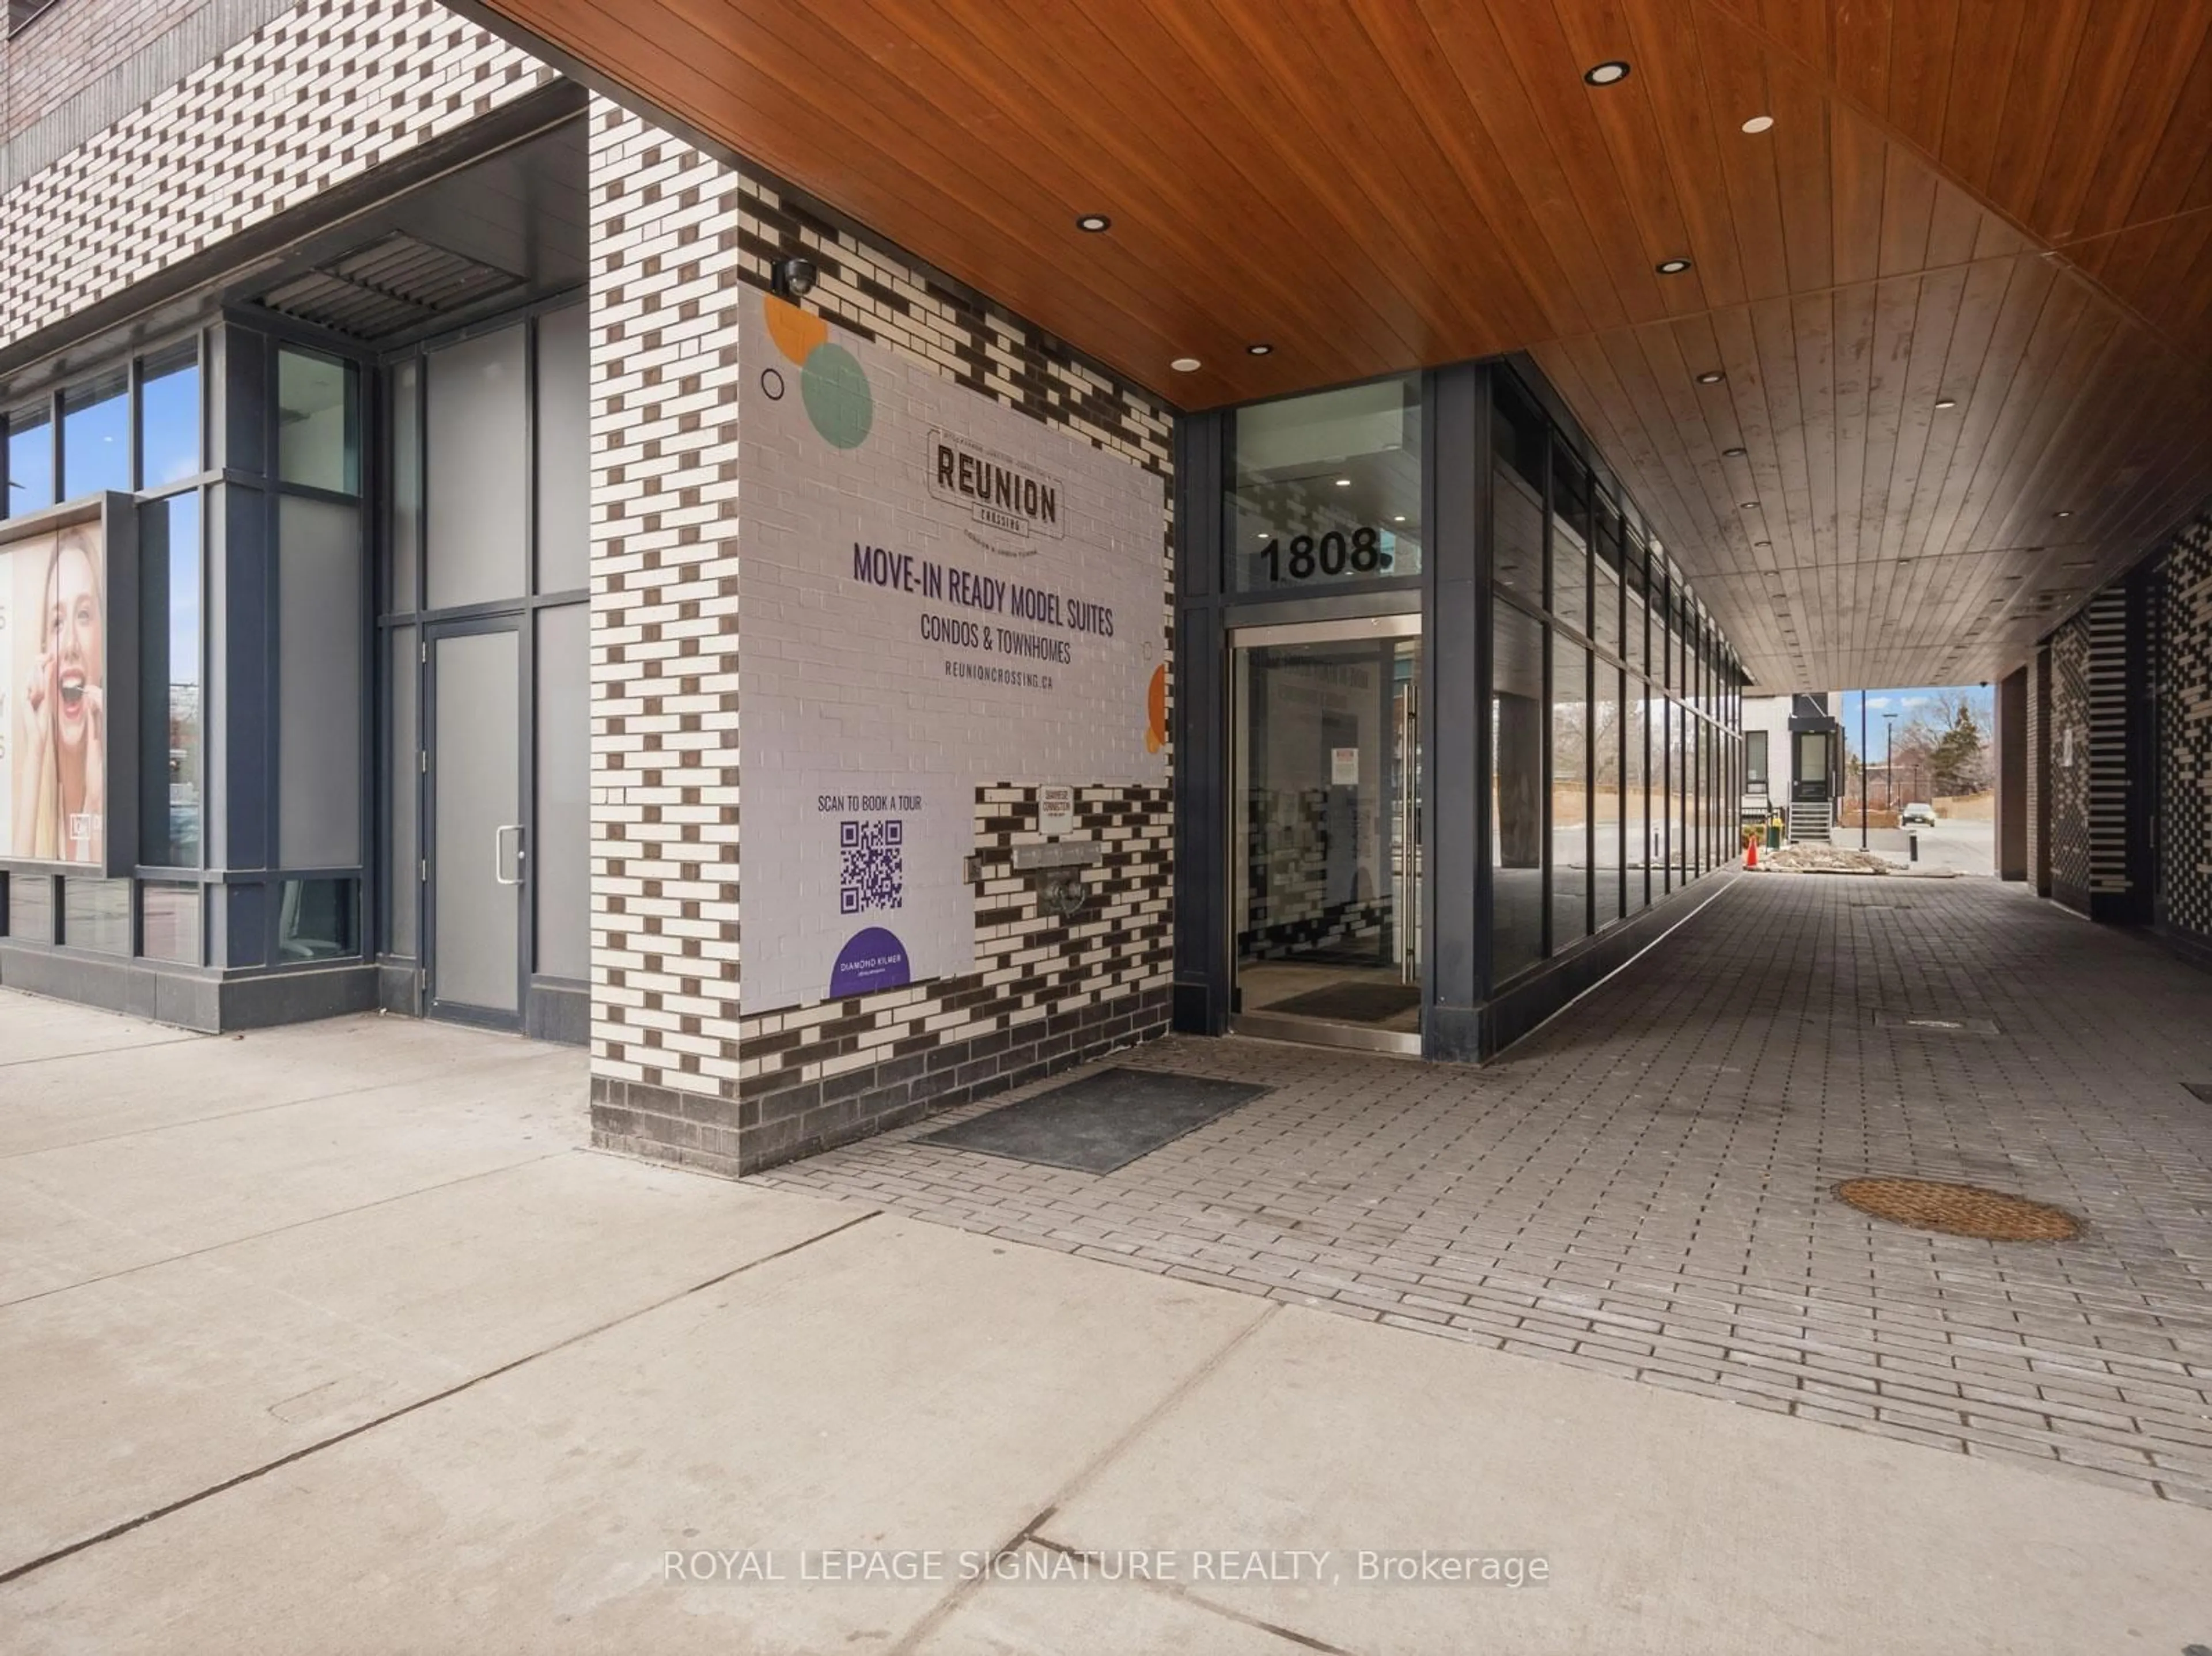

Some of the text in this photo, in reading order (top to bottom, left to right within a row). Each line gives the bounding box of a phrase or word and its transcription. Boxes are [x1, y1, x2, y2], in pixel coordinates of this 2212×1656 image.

[938, 444, 1055, 523] REUNION
[1261, 526, 1378, 582] 1808
[854, 543, 942, 600] MOVE-IN
[949, 568, 1006, 613] READY
[1012, 584, 1063, 626] MODEL
[1067, 598, 1114, 638] SUITES
[921, 613, 1071, 664] CONDOS & TOWNHOMES
[945, 661, 1053, 690] REUNIONCROSSING.CA
[818, 795, 922, 812] SCAN TO BOOK A TOUR
[840, 958, 876, 972] DIAMOND
